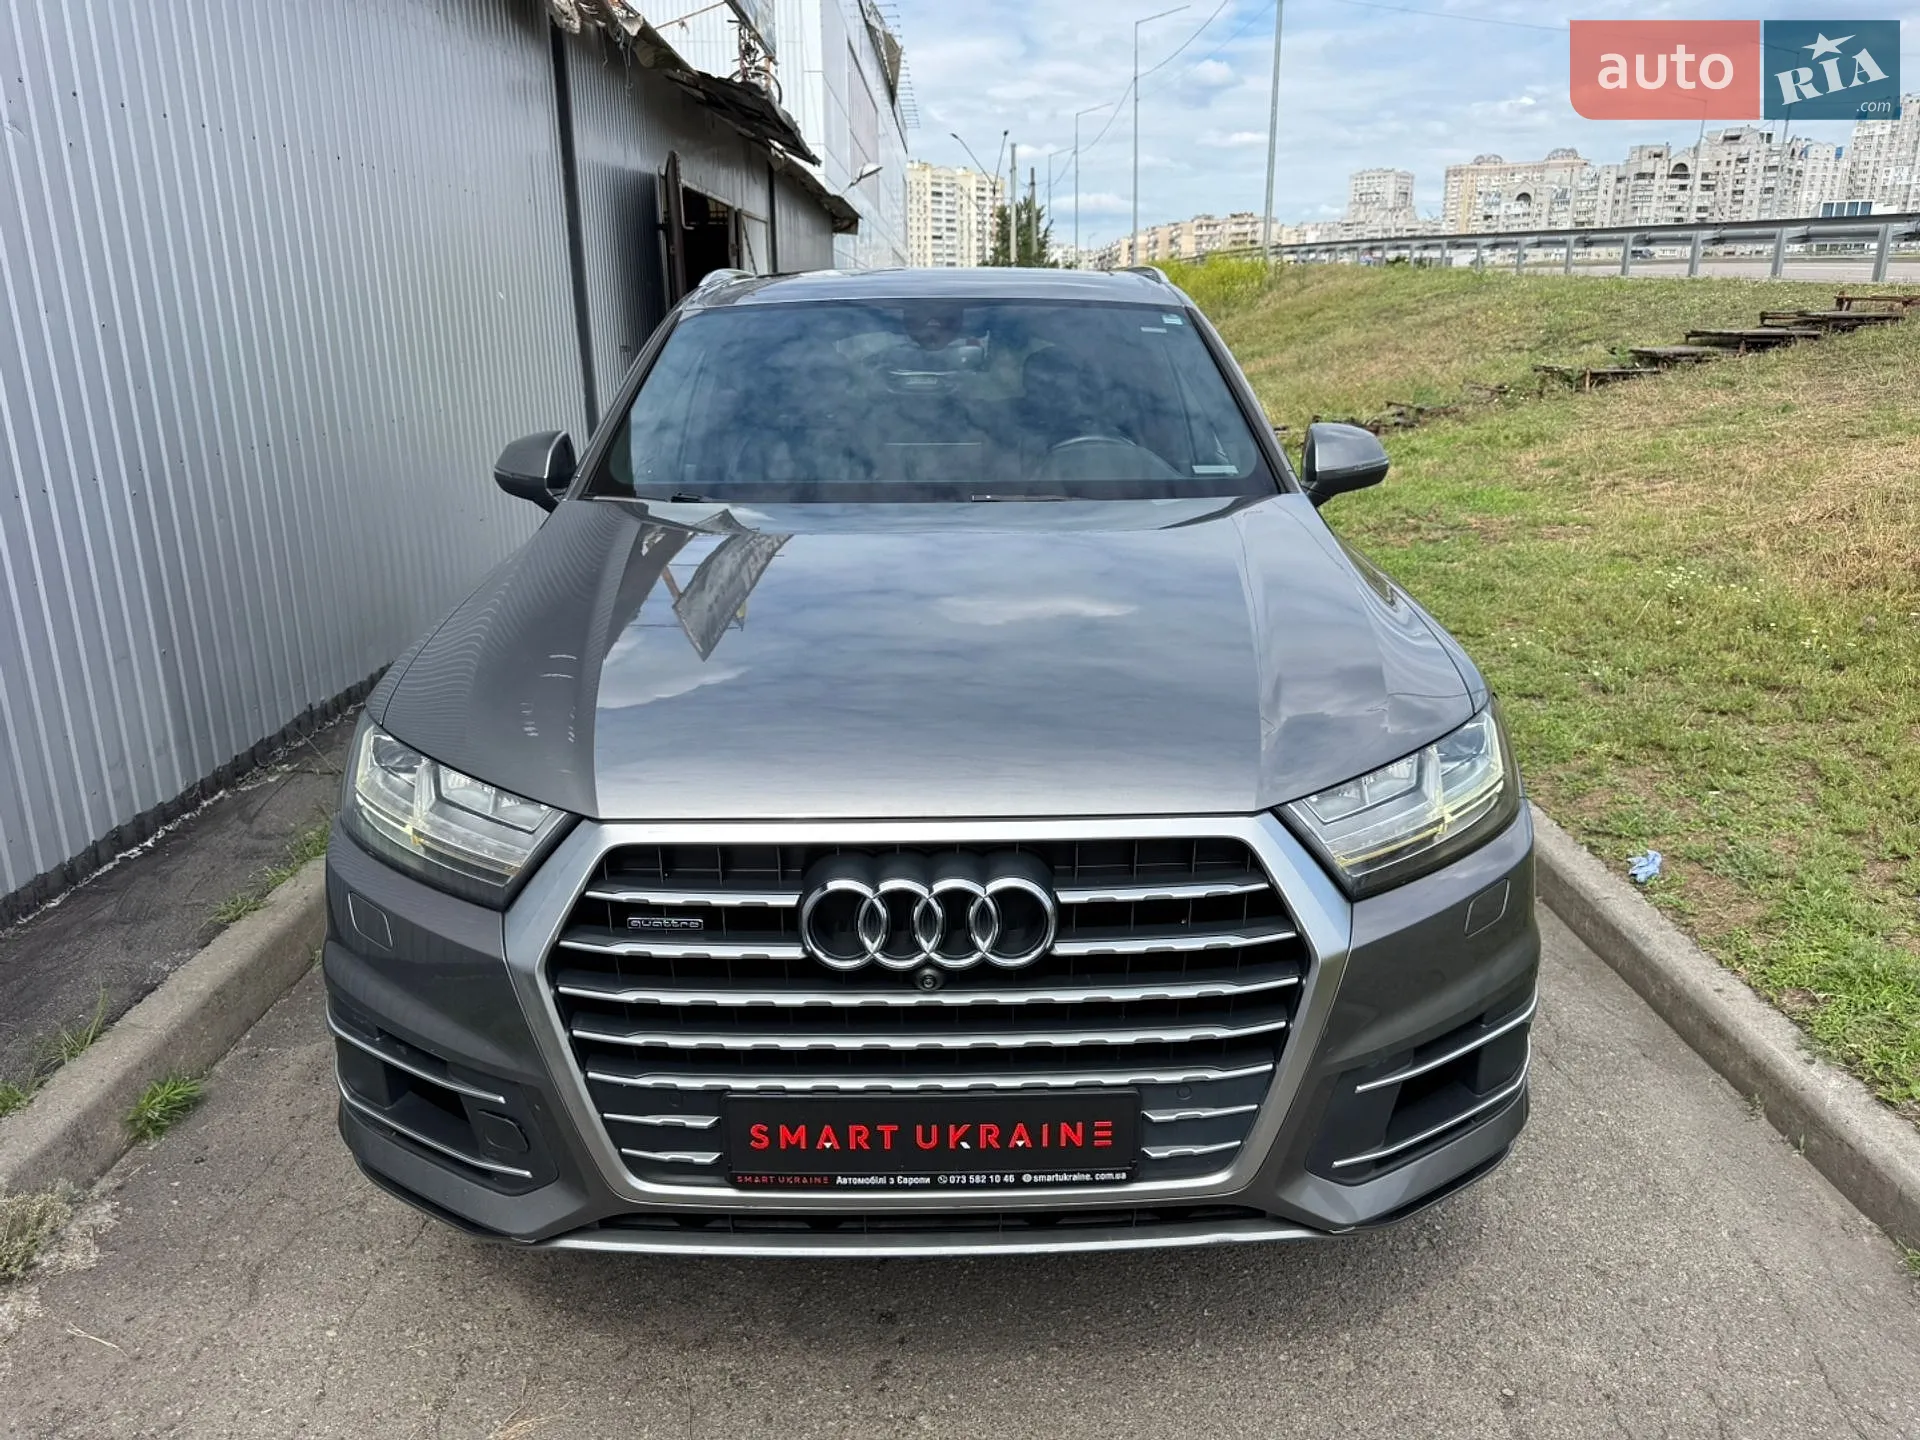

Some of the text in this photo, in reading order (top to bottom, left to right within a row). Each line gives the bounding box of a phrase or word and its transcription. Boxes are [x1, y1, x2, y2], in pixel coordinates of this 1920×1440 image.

[630, 919, 699, 928] quattro
[750, 1121, 1112, 1150] SMART UKRAINE
[736, 1175, 775, 1184] SMART
[836, 1175, 887, 1185] Автомобілі
[897, 1175, 931, 1187] Європи
[949, 1174, 967, 1184] 073
[989, 1174, 1001, 1184] 10
